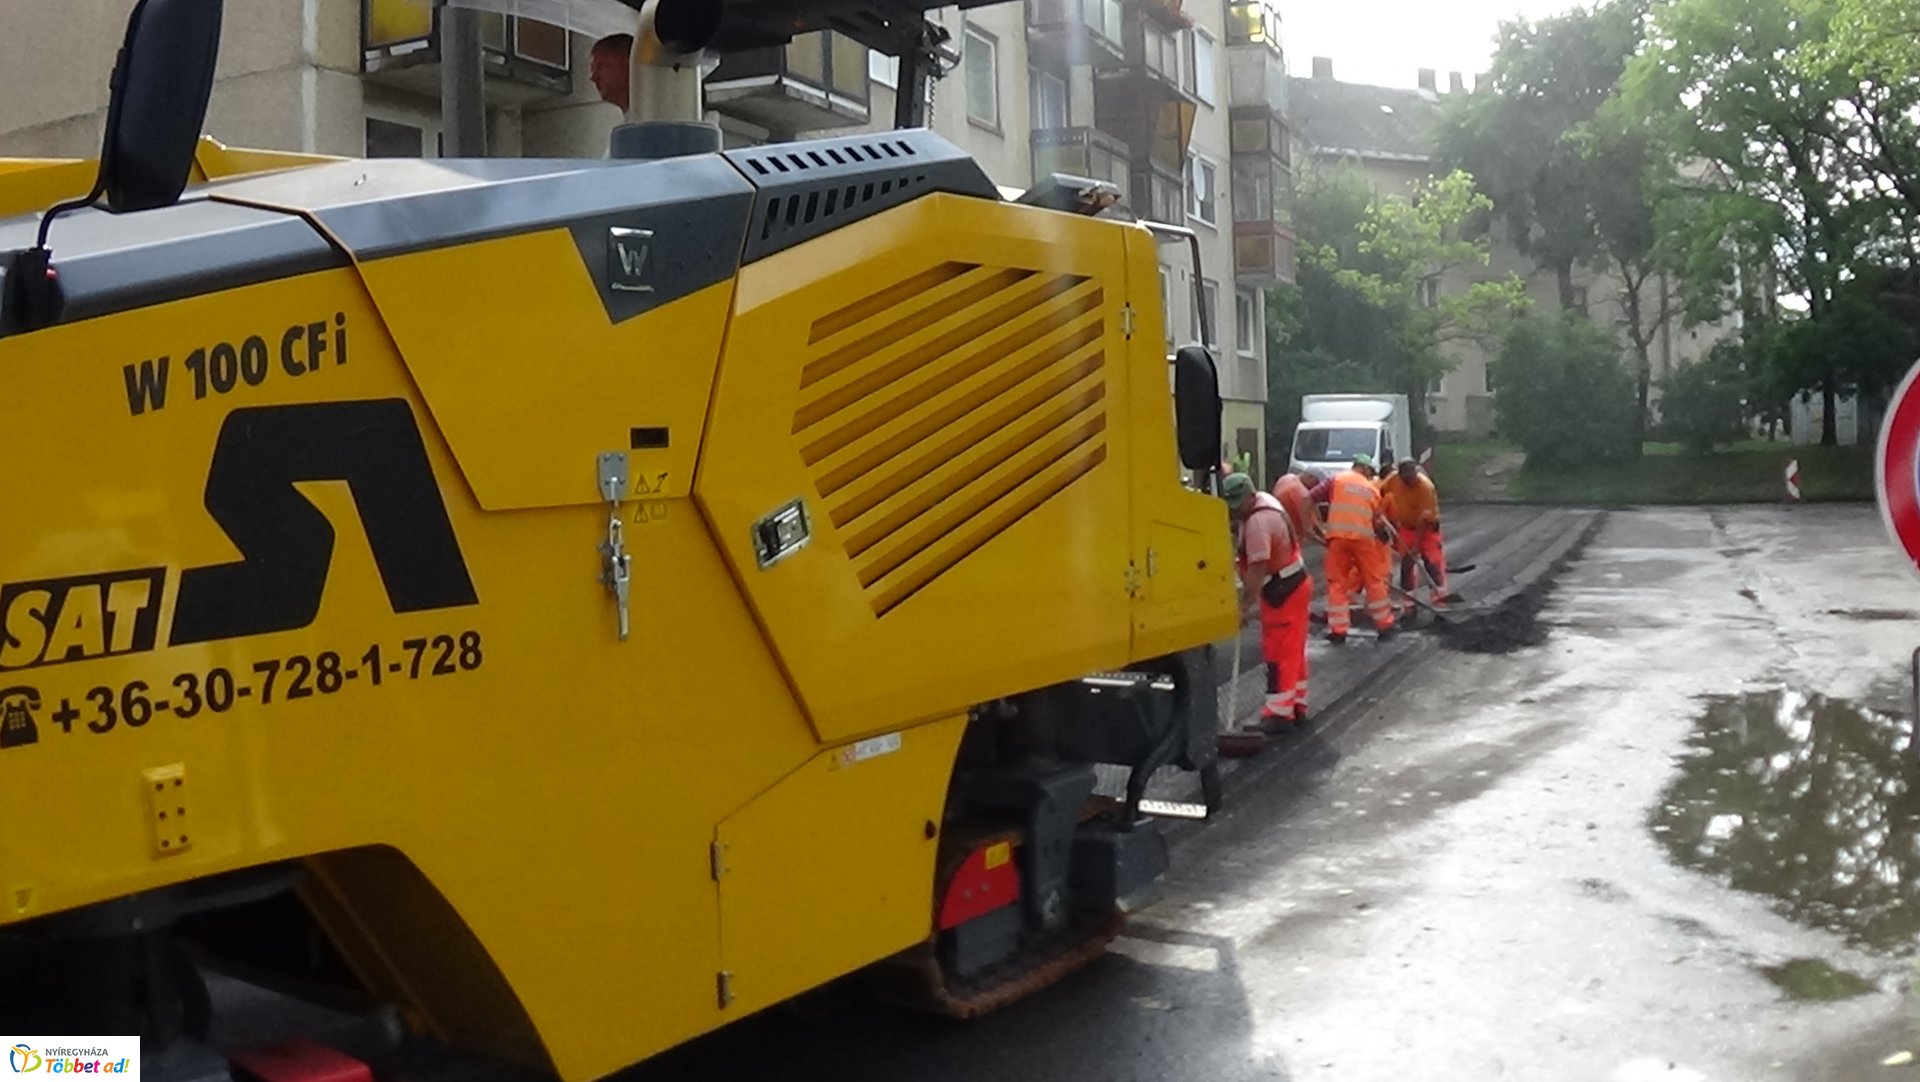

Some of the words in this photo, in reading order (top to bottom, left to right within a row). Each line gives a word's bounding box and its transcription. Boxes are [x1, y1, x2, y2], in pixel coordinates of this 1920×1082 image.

[617, 242, 648, 276] W
[123, 355, 170, 416] W
[184, 332, 269, 400] 100
[0, 577, 151, 668] SAT
[51, 631, 483, 734] +36-30-728-1-728
